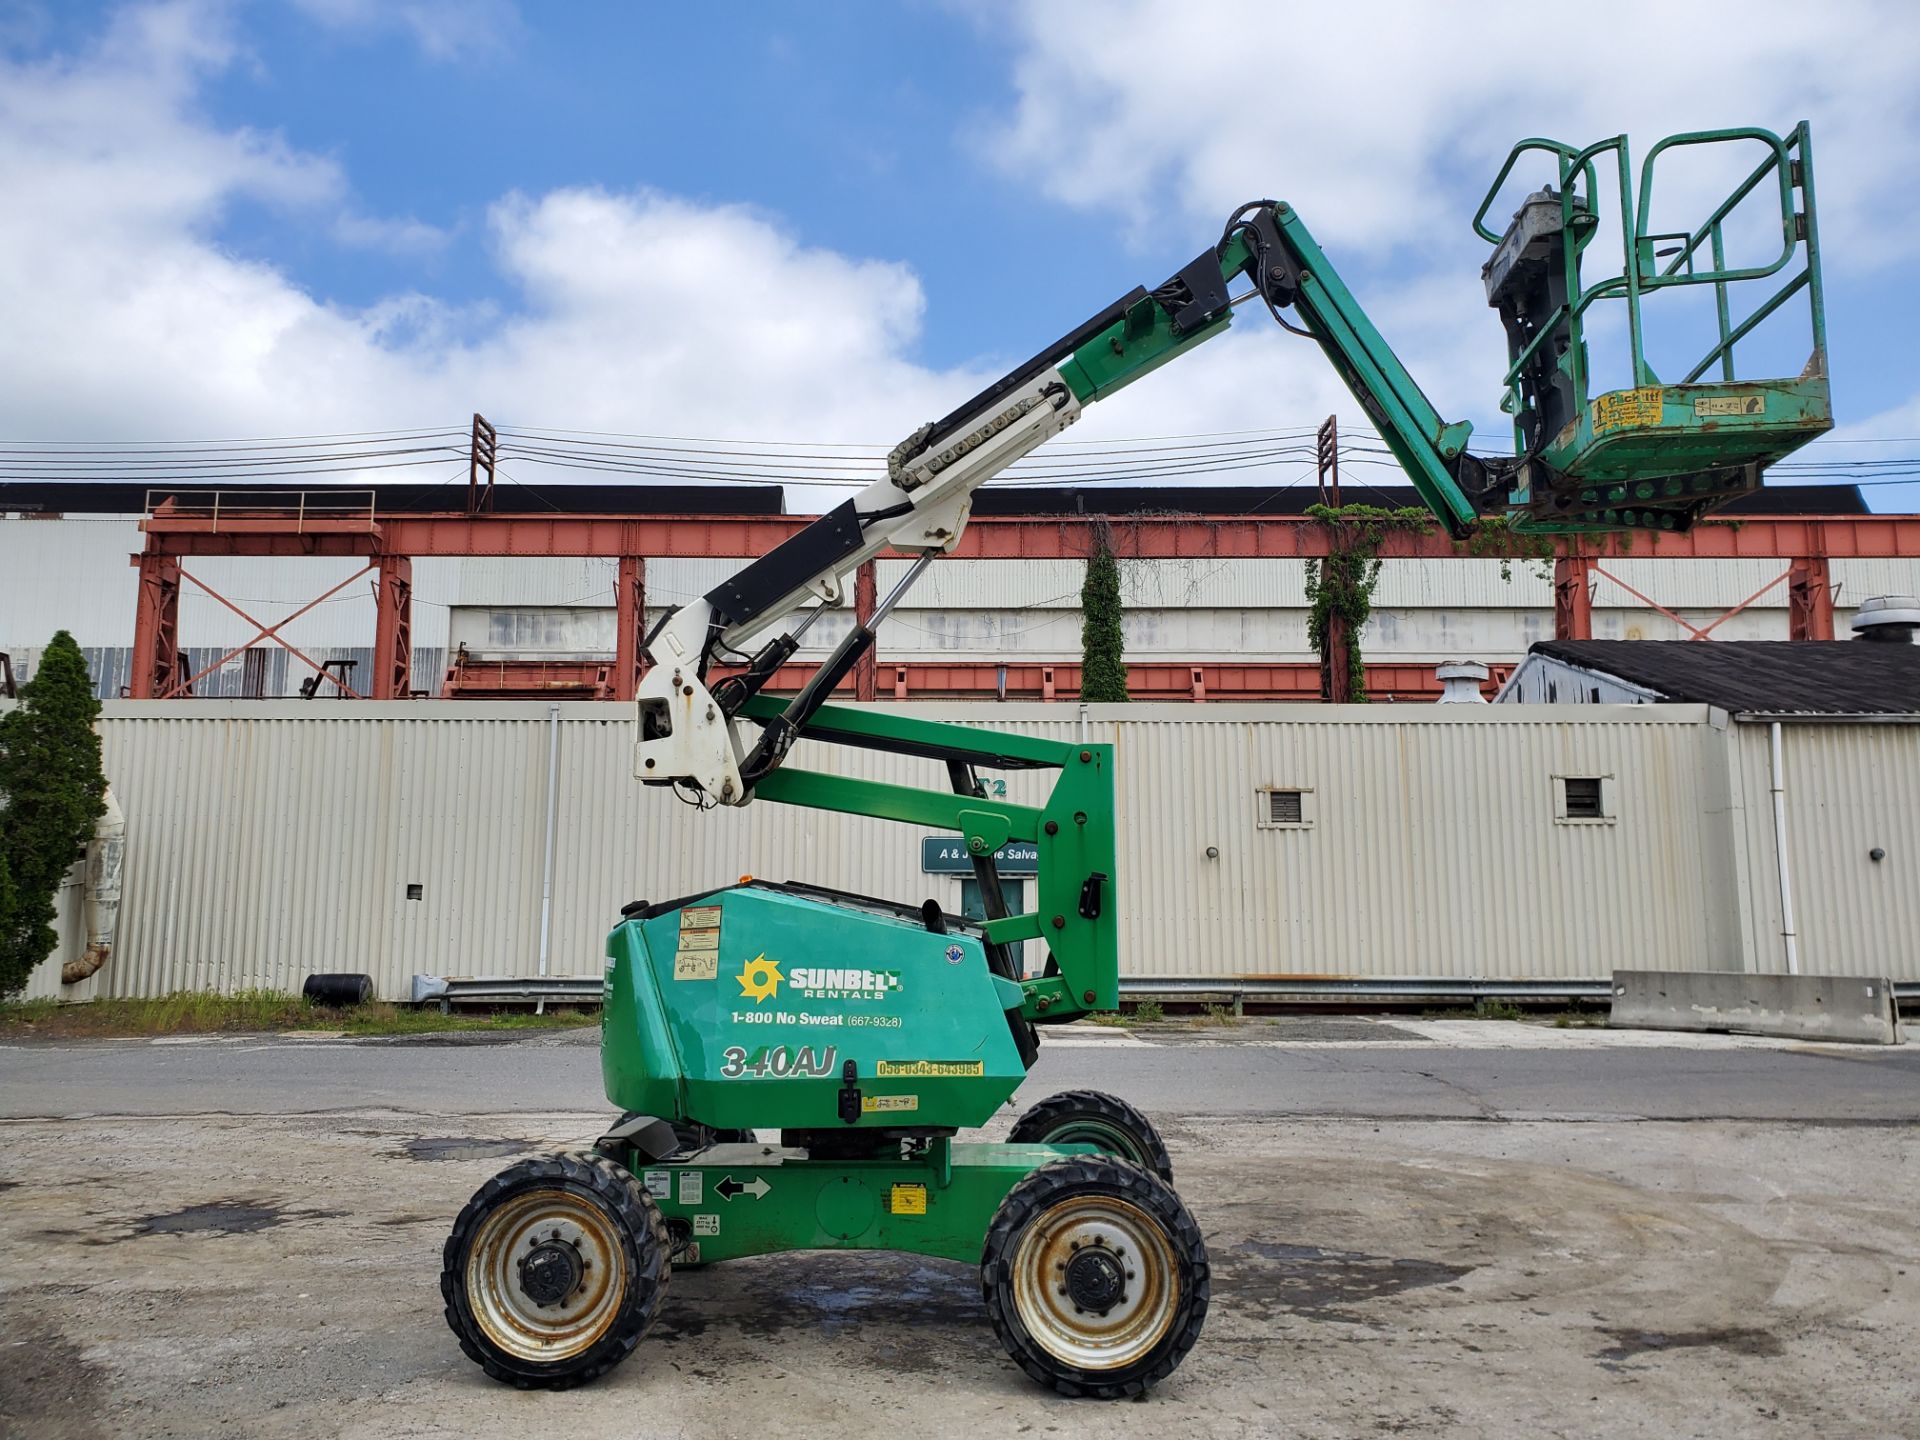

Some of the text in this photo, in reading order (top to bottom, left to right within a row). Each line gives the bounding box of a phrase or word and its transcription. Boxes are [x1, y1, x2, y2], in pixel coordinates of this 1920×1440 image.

[993, 779, 1007, 795] 2
[939, 848, 949, 859] A
[951, 848, 960, 859] &
[1007, 848, 1039, 861] Salva
[804, 989, 884, 1000] RENTALS
[731, 1012, 902, 1028] 1-800 No Sweat (667-9328)
[720, 1045, 837, 1078] 340AJ
